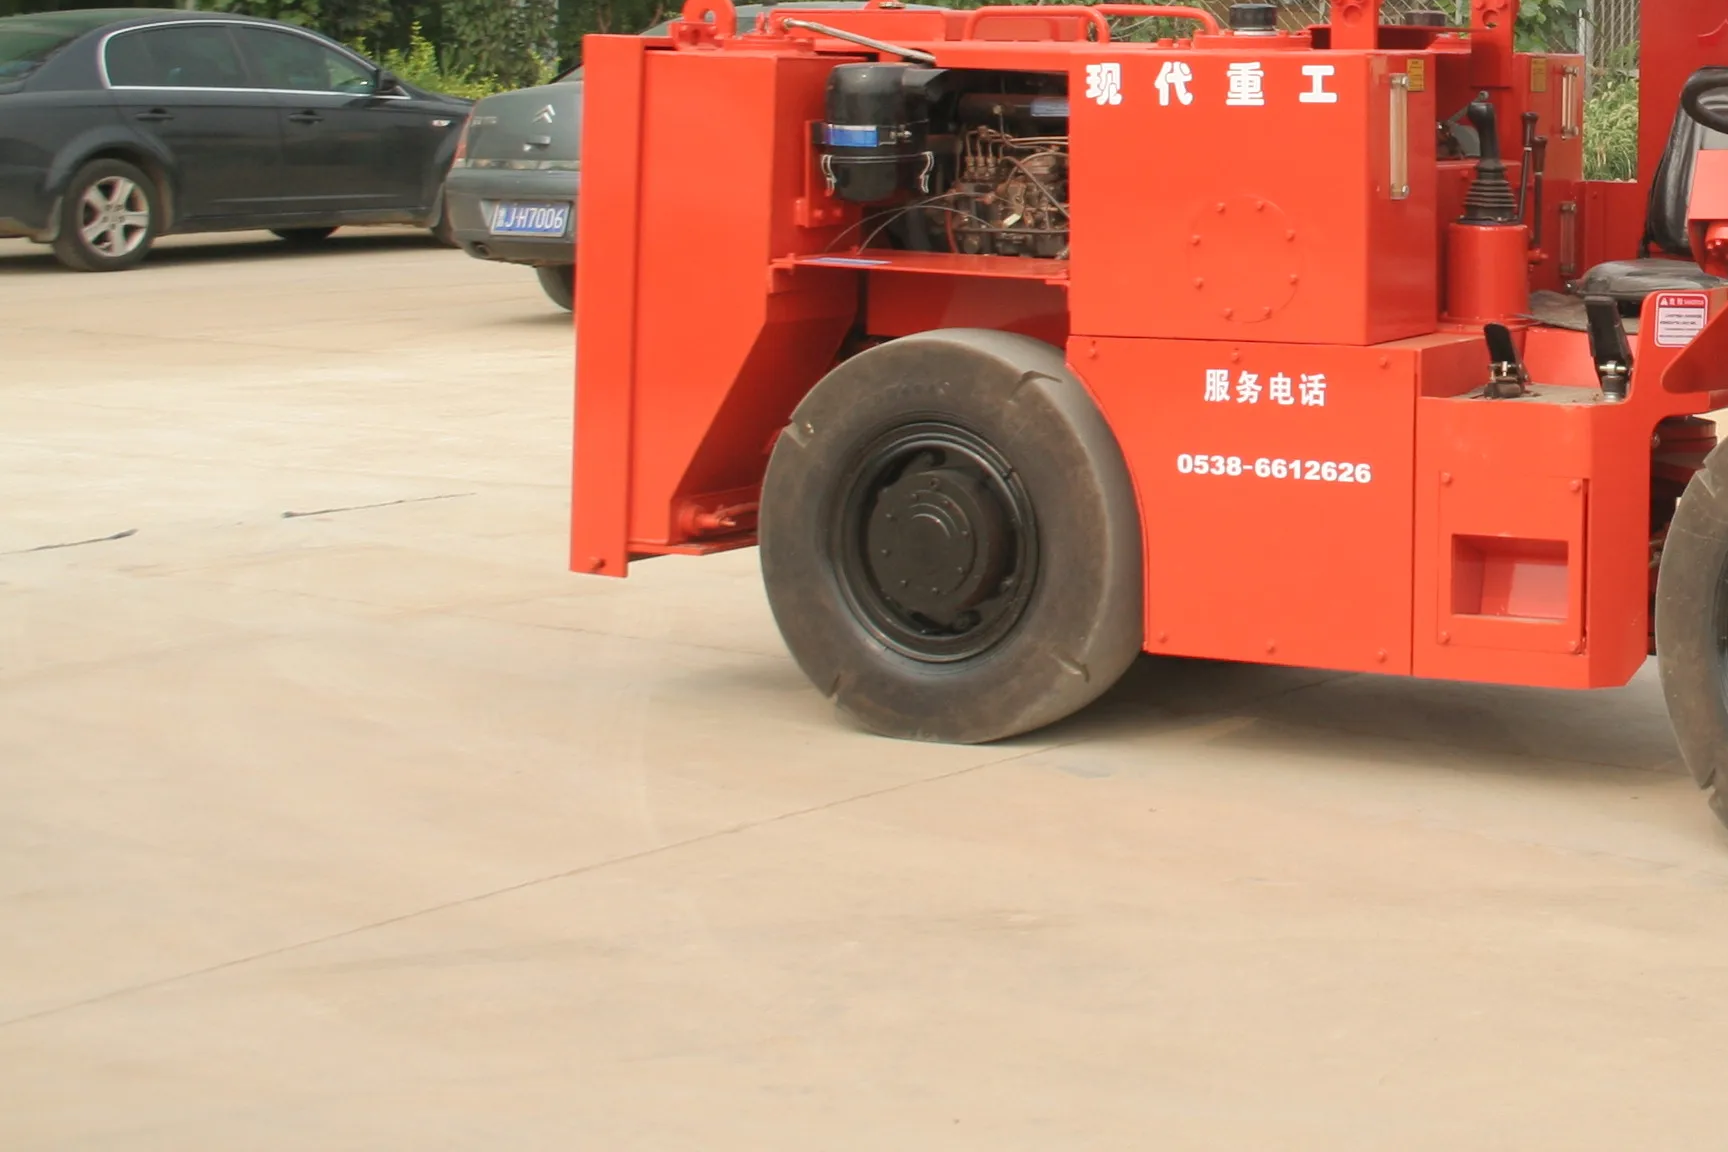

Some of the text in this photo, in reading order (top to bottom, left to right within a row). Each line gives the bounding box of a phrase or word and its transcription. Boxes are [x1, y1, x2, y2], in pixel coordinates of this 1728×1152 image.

[1085, 61, 1338, 106] 现代重工
[1204, 369, 1327, 407] 服务电话
[1177, 453, 1371, 484] 0538-6612626
